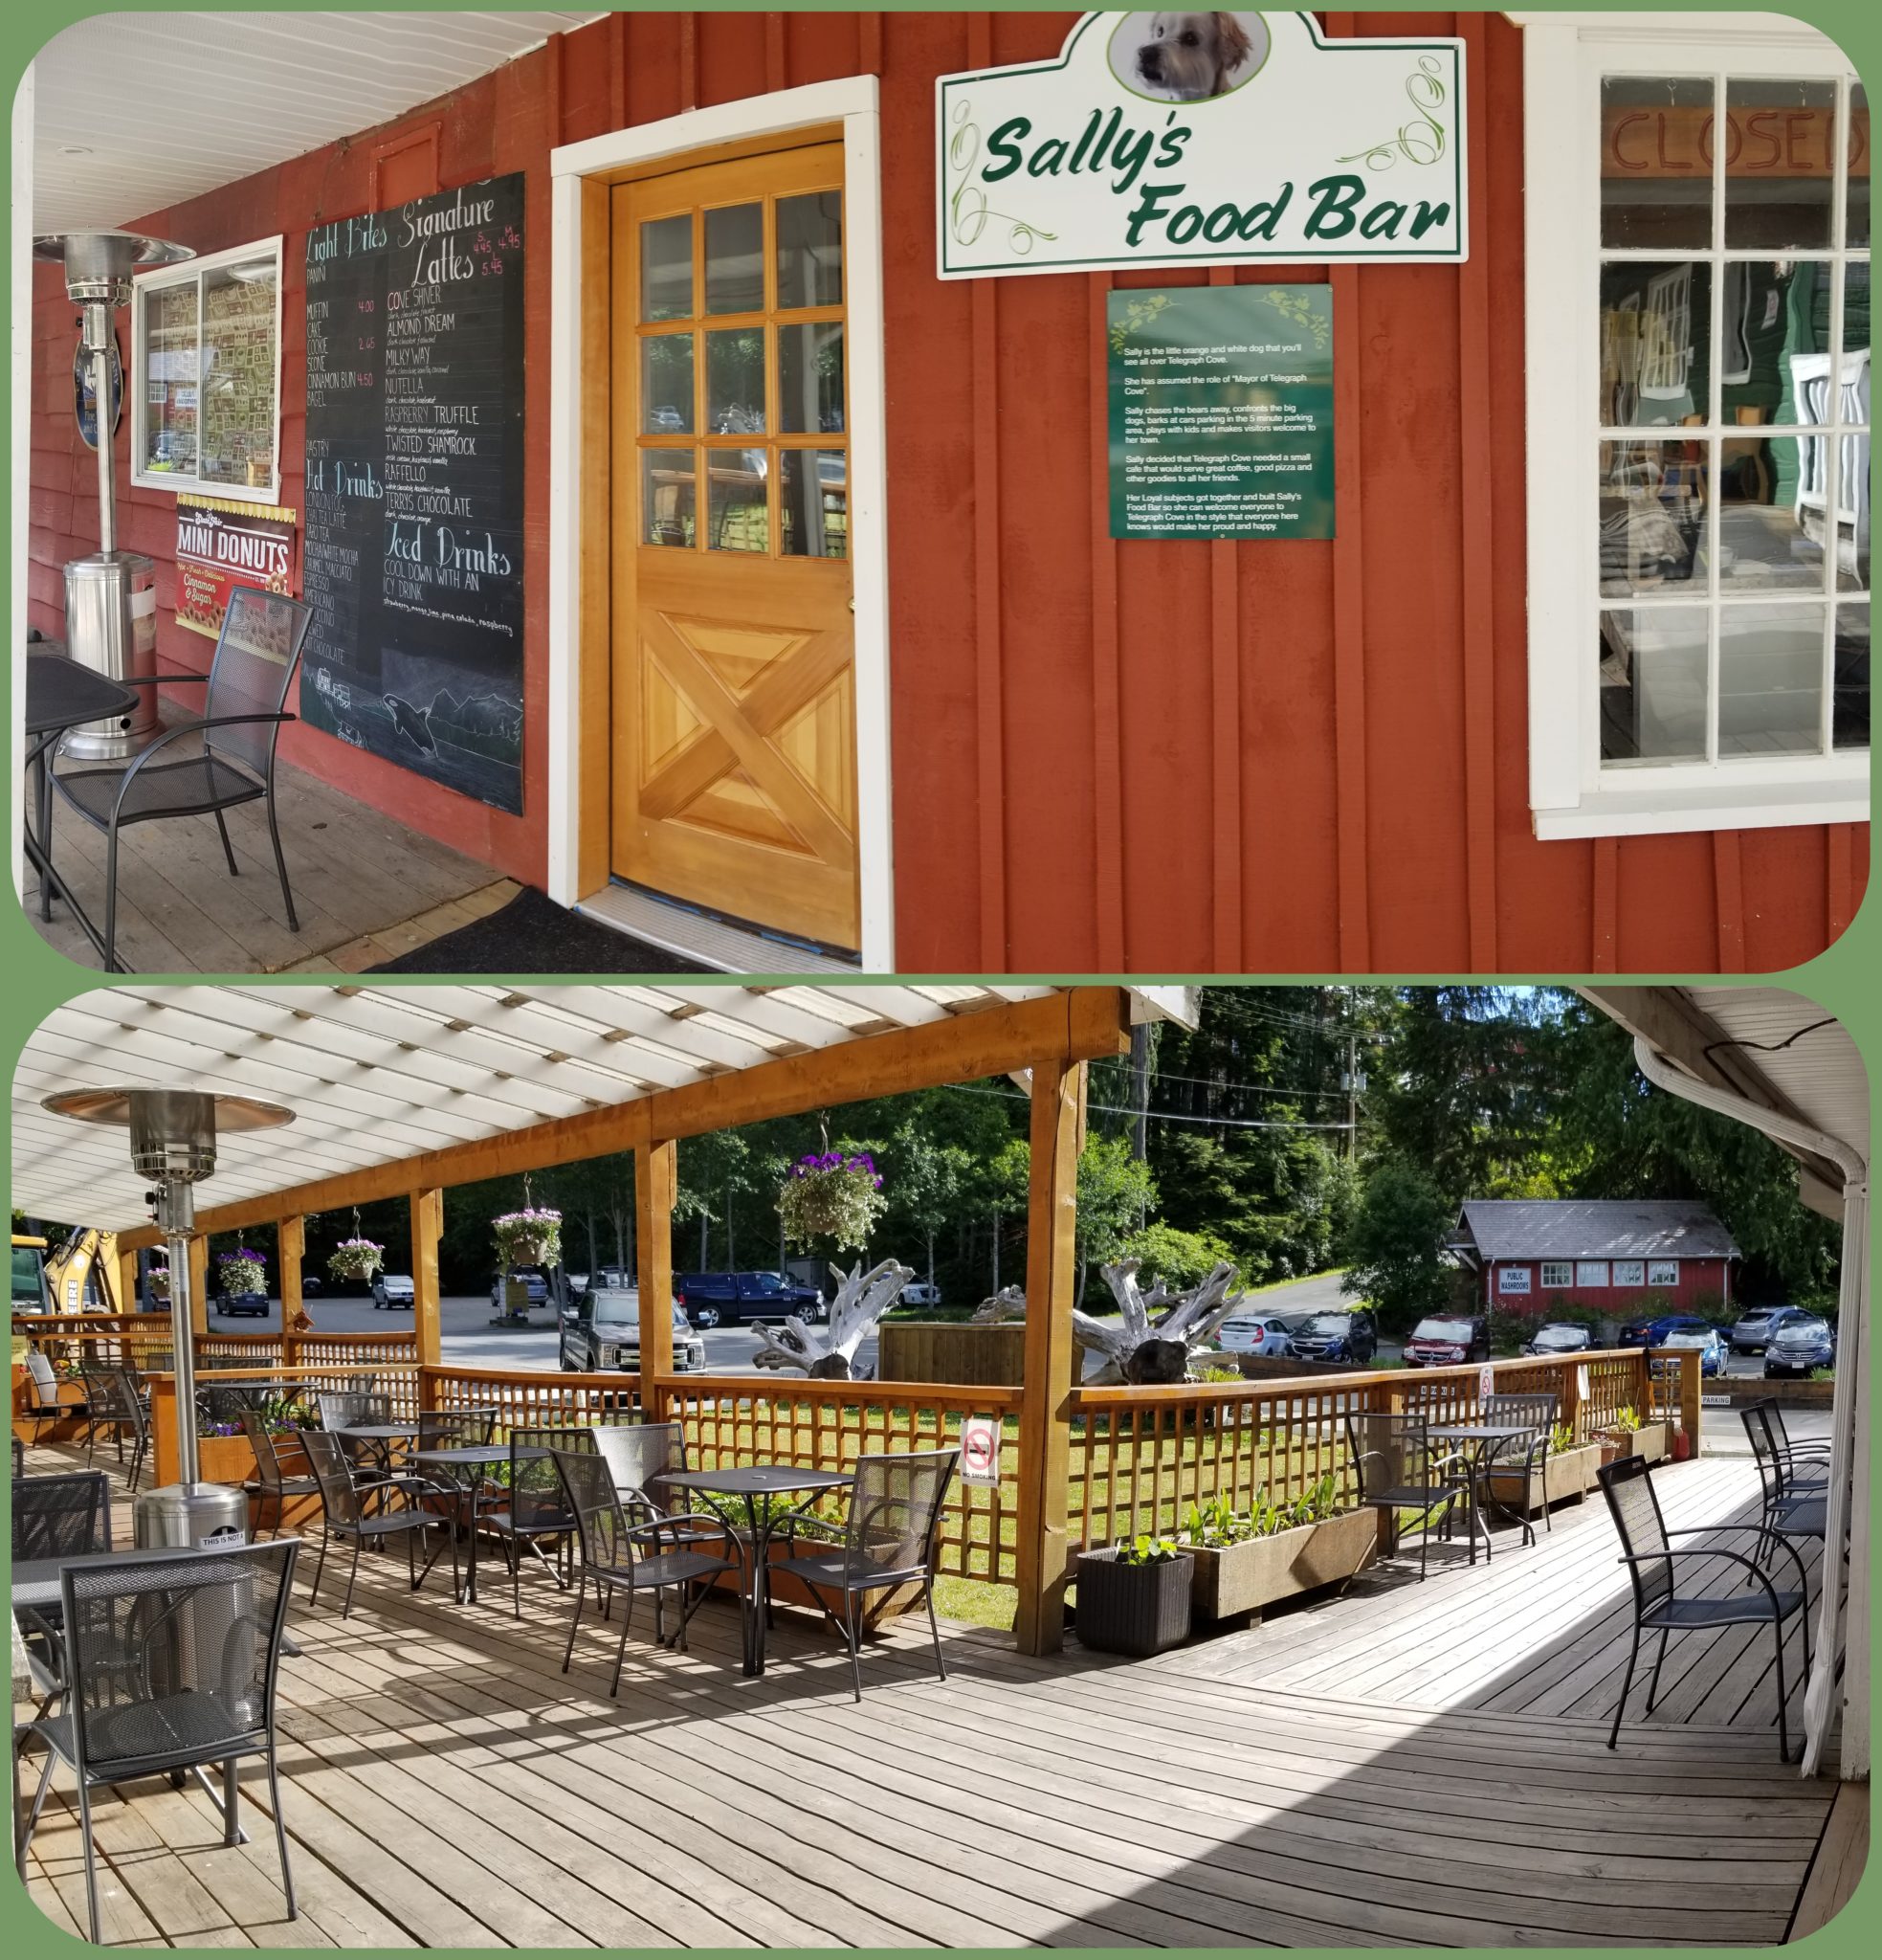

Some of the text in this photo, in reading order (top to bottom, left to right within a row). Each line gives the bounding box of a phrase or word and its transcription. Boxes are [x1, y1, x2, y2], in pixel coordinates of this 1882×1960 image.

[982, 106, 1192, 193] Sally's
[1612, 112, 1865, 169] CLOSED
[397, 188, 494, 248] Signature
[1125, 174, 1450, 248] Food Bar
[306, 213, 387, 266] Light Bites
[410, 235, 475, 288] Lattes
[481, 260, 503, 276] 5.45
[306, 265, 326, 285] PANINI
[358, 300, 375, 314] 4.00
[387, 290, 410, 311] COVE
[306, 301, 329, 321] MUFFIN
[306, 321, 322, 339] CAKE
[387, 318, 422, 337] ALMOND
[424, 313, 455, 333] DREAM
[307, 337, 329, 355] COOKIE
[386, 345, 431, 366] MILKY WAY
[1123, 347, 1142, 356] Sally
[1249, 345, 1264, 354] dog
[307, 355, 326, 372] SCONE
[1140, 357, 1149, 366] all
[1167, 357, 1205, 366] Telegraph
[307, 371, 356, 389] CINNAMON BUN
[357, 372, 374, 387] 4.50
[385, 377, 424, 394] NUTELLA
[1141, 376, 1156, 385] has
[1206, 375, 1221, 384] role
[1270, 374, 1308, 384] Telegraph
[307, 390, 327, 407] BAGEL
[385, 405, 480, 425] RASPBERRY TRUFFLE
[1124, 407, 1143, 415] Sally
[1144, 406, 1172, 414] chases
[1232, 405, 1269, 413] confronts
[1284, 405, 1296, 413] big
[1146, 415, 1168, 424] barks
[1197, 415, 1226, 424] parking
[1284, 414, 1314, 423] parking
[1145, 426, 1166, 434] plays
[1184, 425, 1200, 434] kids
[306, 439, 329, 457] PASTRY
[385, 435, 477, 456] TWISTED SHAMROCK
[1140, 435, 1161, 444] town.
[306, 458, 384, 499] Hot Drinks
[385, 463, 426, 482] RAFFELLO
[417, 494, 474, 518] CHOCOLATE
[178, 523, 289, 575] MINI DONUTS
[433, 526, 512, 575] Drinks
[184, 573, 217, 593] Cinnamon
[304, 570, 330, 592] ESPRESSO
[384, 558, 480, 591] COOL DOWN WITH AN
[186, 588, 212, 607] & Sugar
[383, 577, 423, 601] ICY DRINK
[479, 618, 514, 637] raspberry
[313, 639, 345, 666] CHOCOLATE
[1501, 1281, 1529, 1290] WASHROOMS
[1507, 1272, 1523, 1281] PUBLIC
[68, 1280, 78, 1315] EERE
[203, 1538, 220, 1547] THIS
[227, 1533, 240, 1542] NOT
